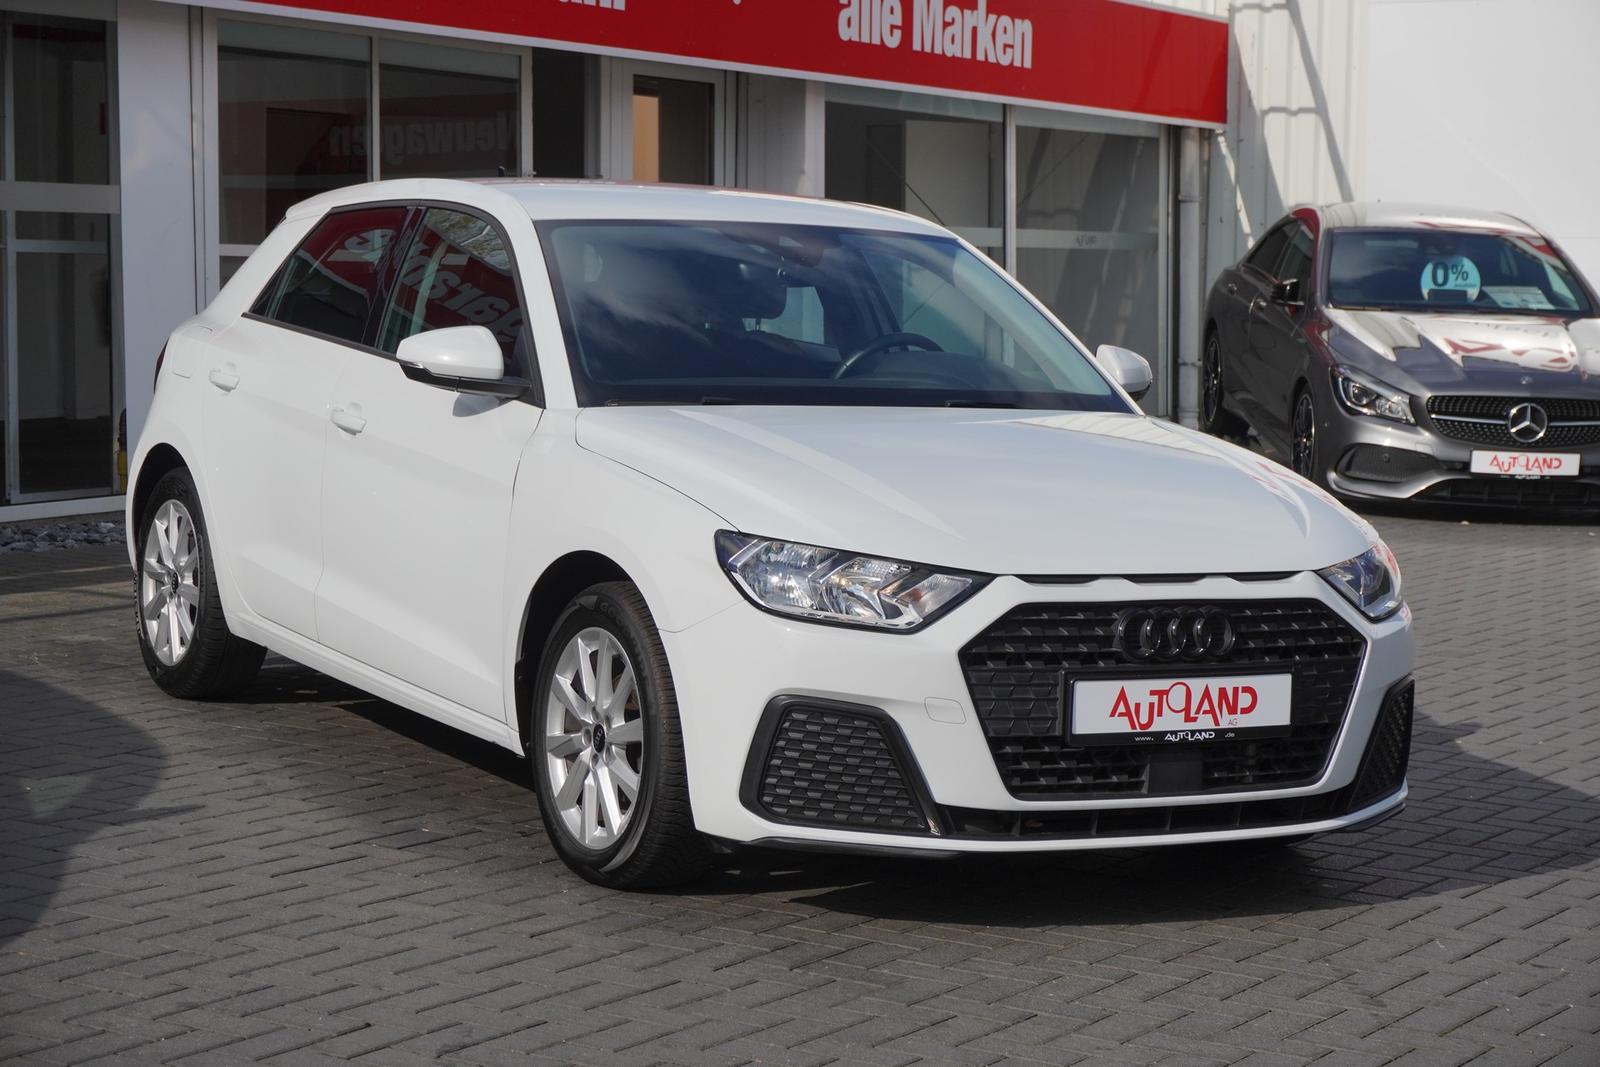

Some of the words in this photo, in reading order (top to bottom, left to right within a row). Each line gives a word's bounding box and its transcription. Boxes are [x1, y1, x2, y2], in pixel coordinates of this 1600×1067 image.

[838, 0, 903, 48] alle
[912, 0, 1033, 69] Marken
[1431, 261, 1469, 288] 0%
[1489, 454, 1563, 474] AUTOLAND
[1109, 681, 1258, 731] AUTOLAND
[1227, 718, 1239, 727] AG
